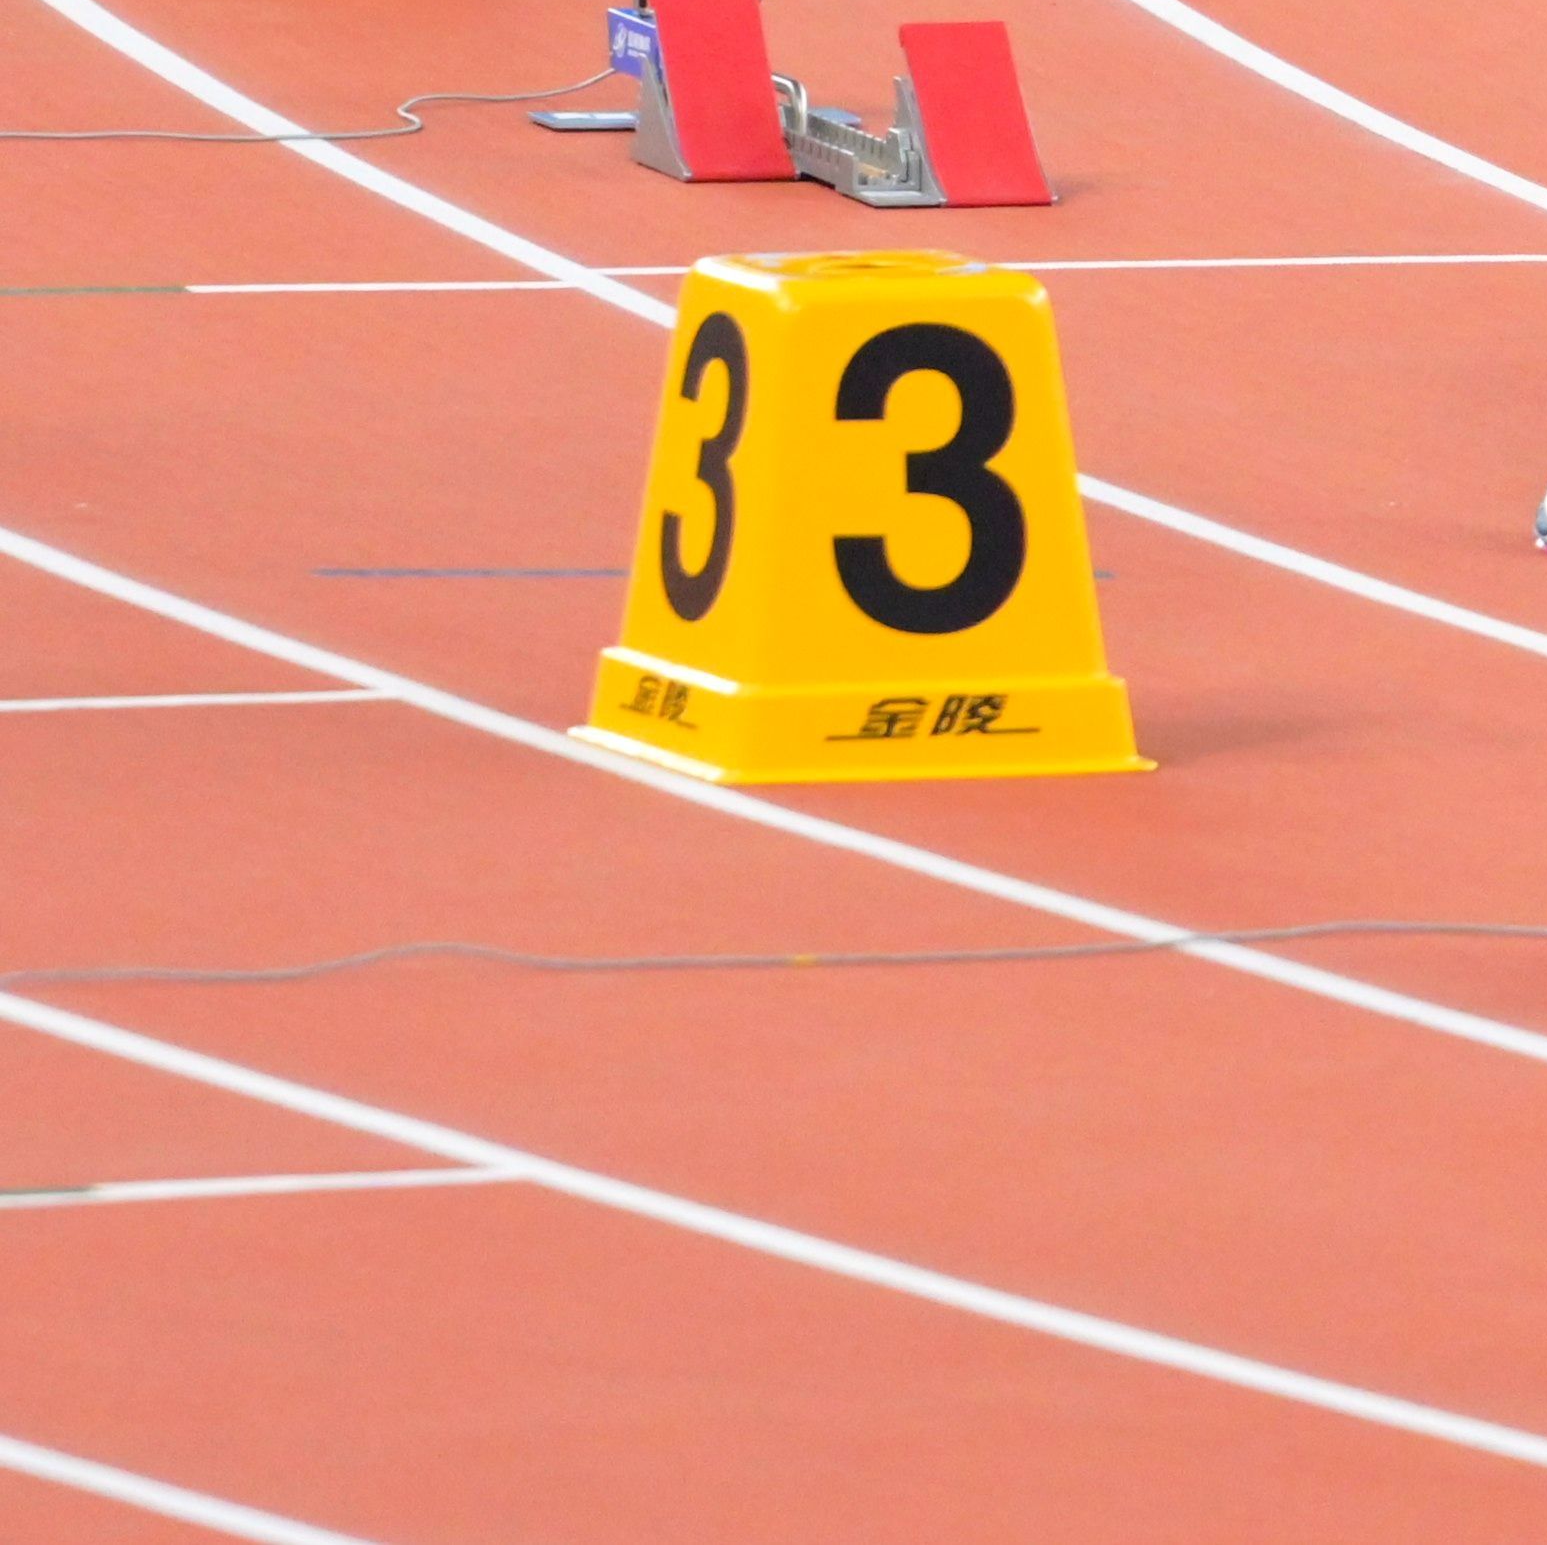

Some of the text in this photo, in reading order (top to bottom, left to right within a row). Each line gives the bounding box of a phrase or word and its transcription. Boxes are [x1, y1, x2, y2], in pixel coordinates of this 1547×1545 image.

[661, 311, 748, 622] 3
[833, 322, 1028, 635] 3
[840, 694, 1026, 741] 金陵
